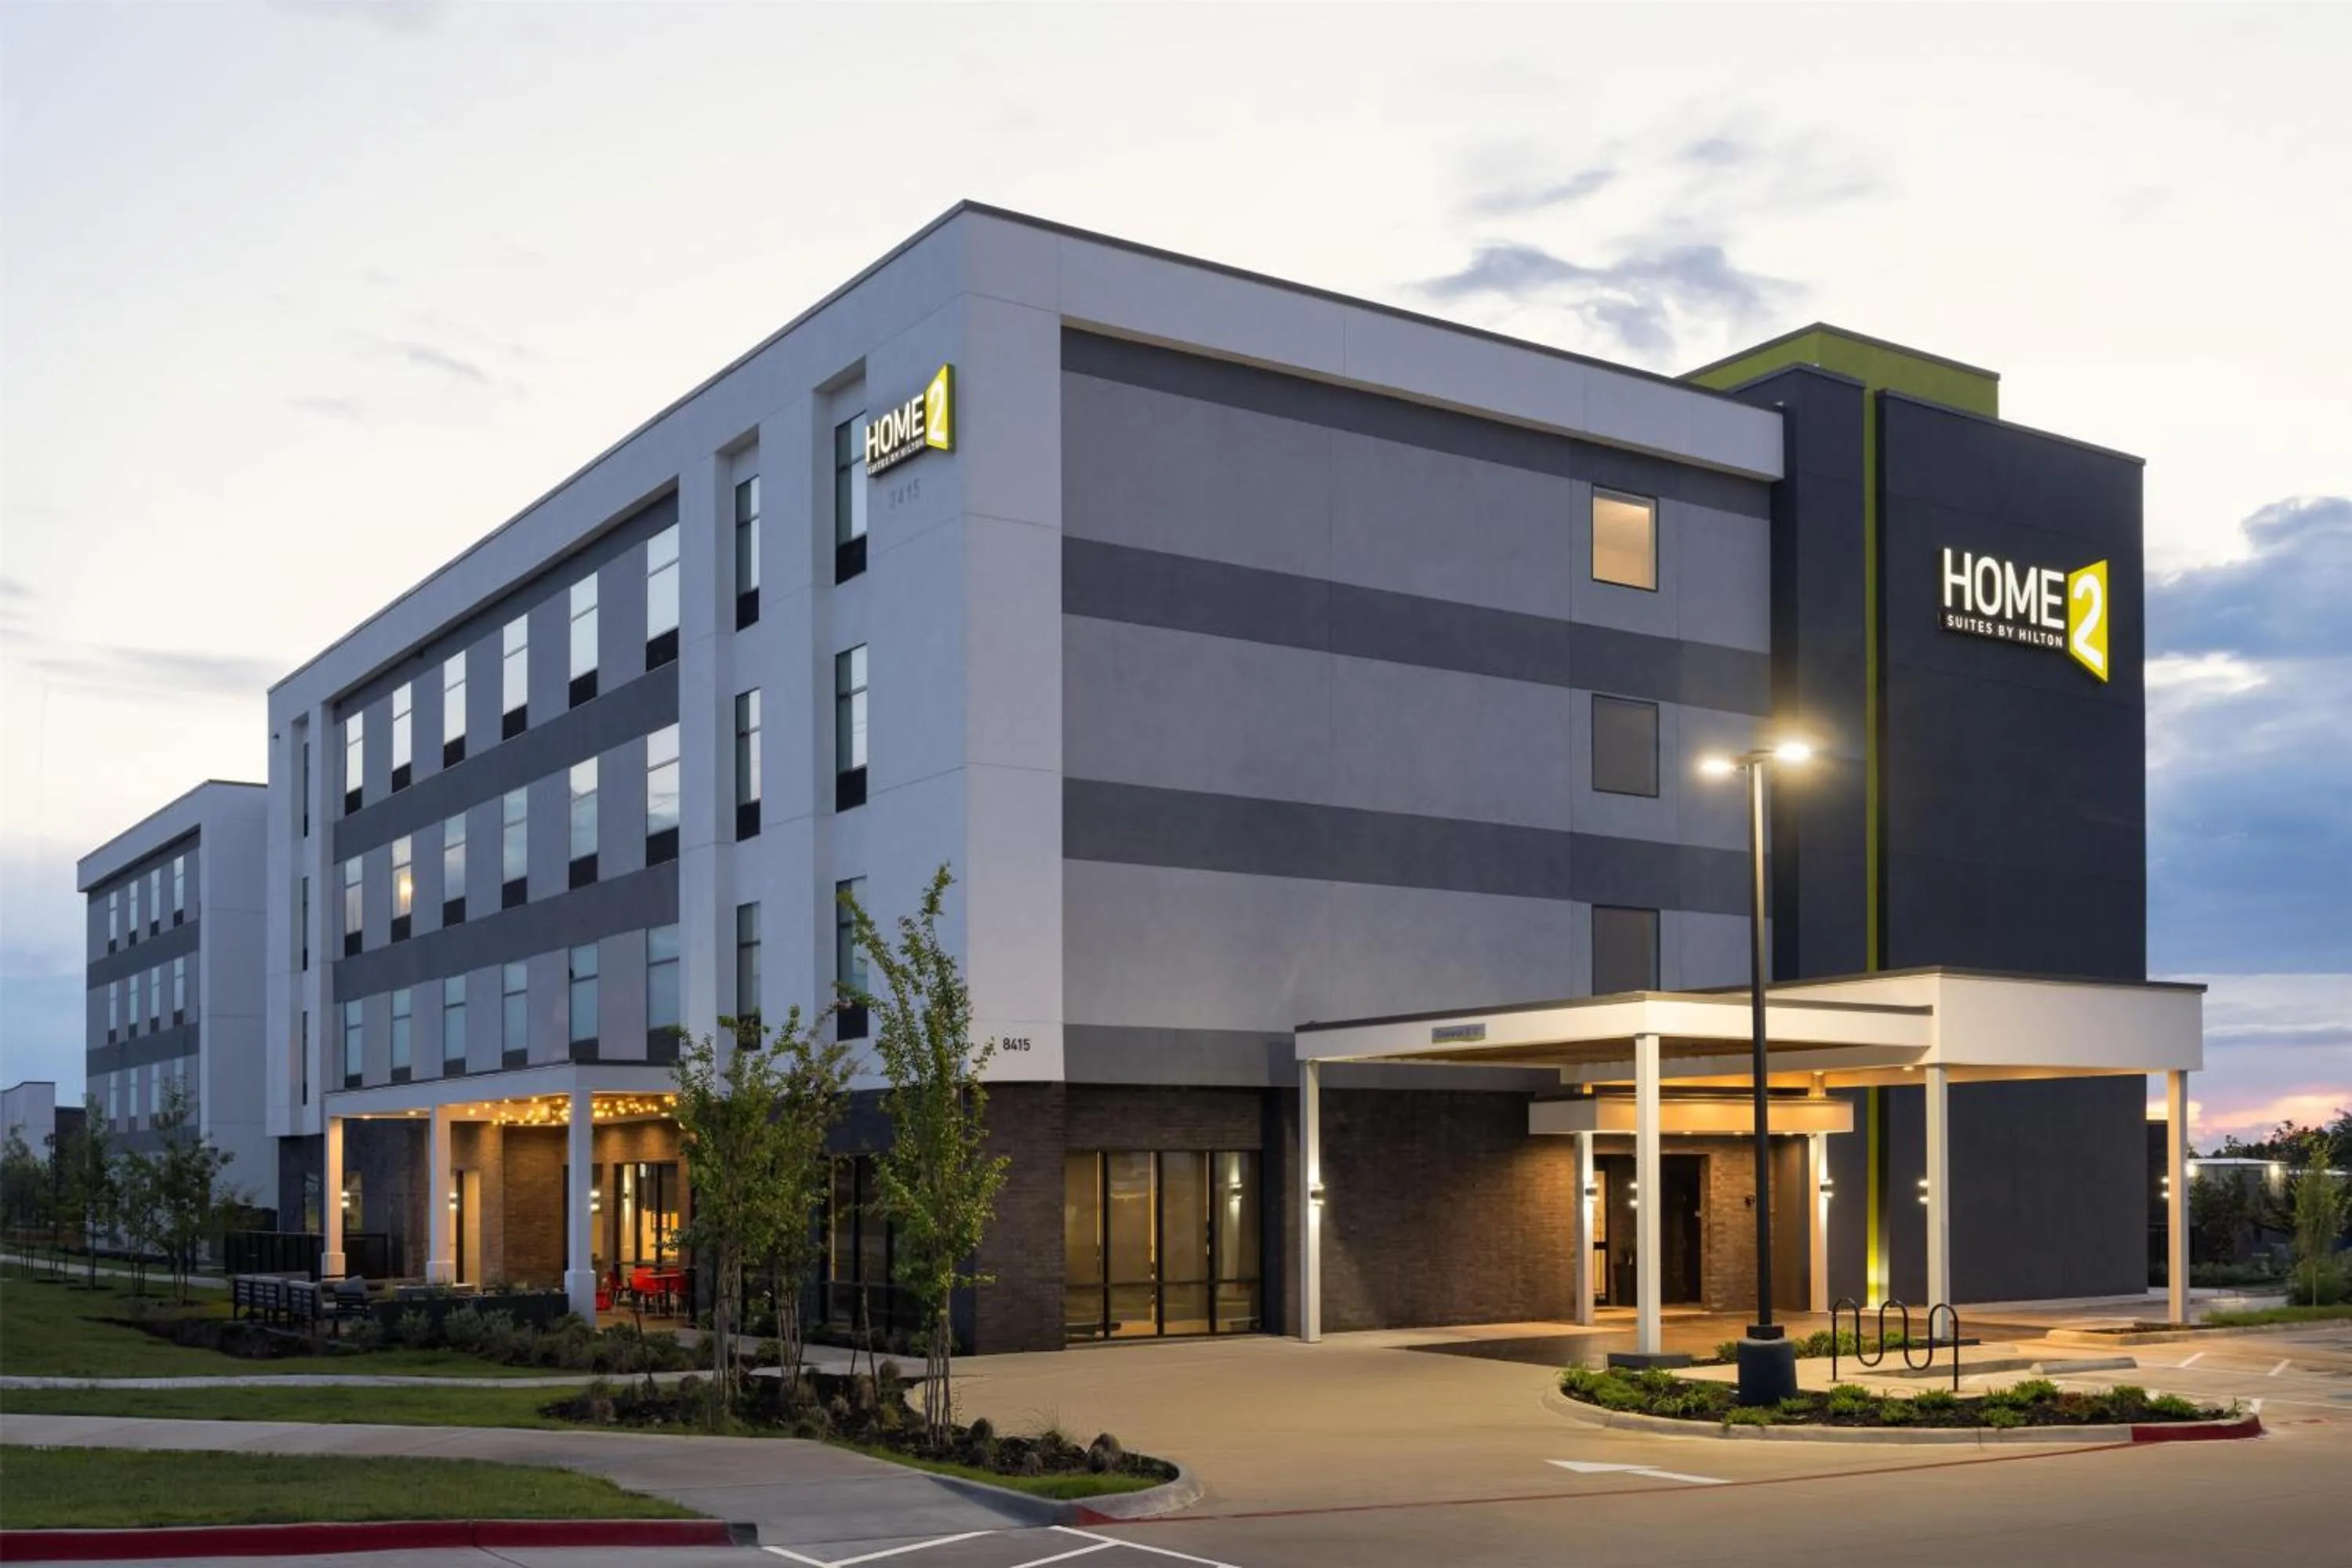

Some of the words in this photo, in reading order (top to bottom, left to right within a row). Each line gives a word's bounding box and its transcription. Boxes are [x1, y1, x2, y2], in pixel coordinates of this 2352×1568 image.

[866, 393, 924, 463] HOME
[928, 379, 948, 442] 2
[1944, 547, 2065, 630] HOME
[2072, 573, 2103, 671] 2
[1947, 614, 1992, 634] SUITES
[1998, 624, 2014, 638] BY
[2019, 628, 2063, 648] HILTON
[1003, 1036, 1031, 1051] 8415
